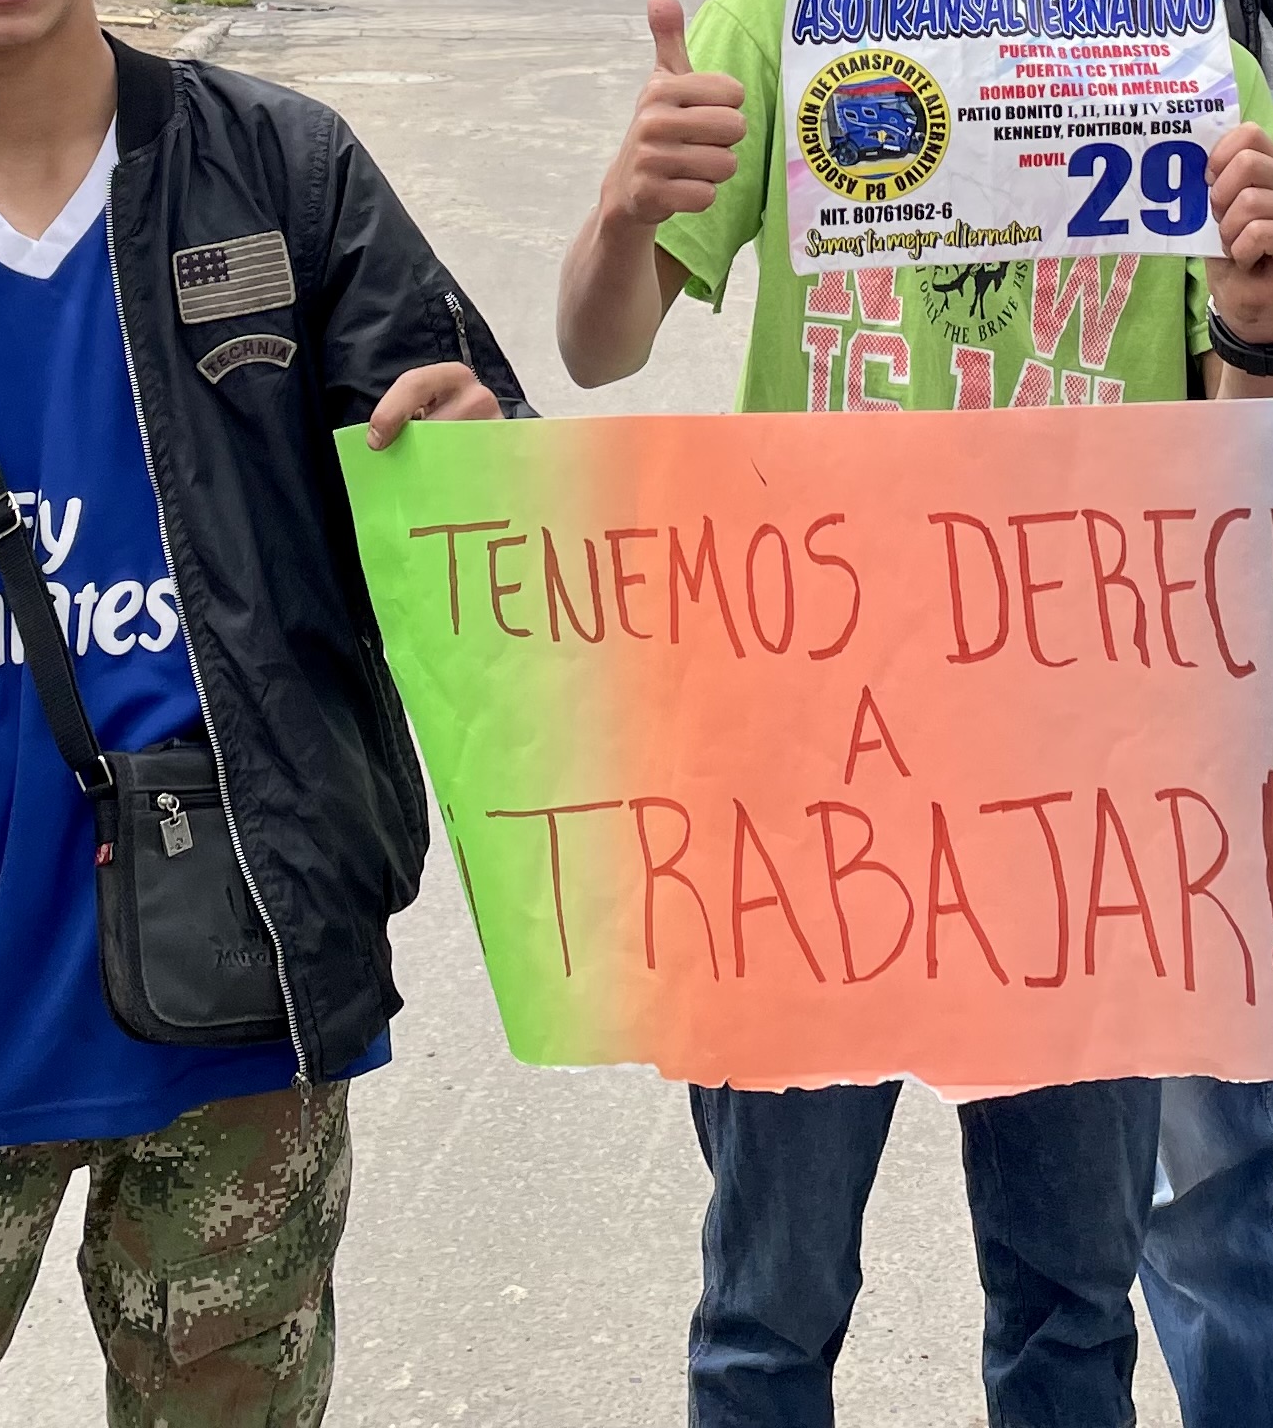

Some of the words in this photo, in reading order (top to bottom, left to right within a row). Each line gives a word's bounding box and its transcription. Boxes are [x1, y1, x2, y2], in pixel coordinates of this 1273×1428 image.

[999, 45, 1055, 59] PUERTA
[1058, 46, 1068, 59] 8
[1070, 44, 1171, 59] CORABASTOS
[826, 53, 933, 95] TRANSPORTE
[1015, 64, 1073, 78] PUERTA
[1074, 65, 1083, 77] 1
[1086, 64, 1107, 77] CC
[1109, 62, 1160, 77] TINTAL
[809, 77, 833, 102] DE
[980, 84, 1045, 101] ROMBOY
[1088, 82, 1118, 97] CON
[1121, 79, 1200, 96] AMÉRICAS
[957, 106, 1001, 122] PATIO
[1005, 104, 1063, 121] BONITO
[1104, 103, 1125, 117] III
[1130, 103, 1139, 118] y
[1142, 101, 1162, 115] IV
[1166, 98, 1225, 115] SECTOR
[893, 92, 947, 192] ALTERNATIVO
[993, 125, 1064, 142] KENNEDY,
[1067, 121, 1147, 138] FONTIBON,
[1150, 119, 1192, 135] BOSA
[798, 101, 859, 195] ASOCIACIÓN
[1019, 152, 1067, 168] MOVIL
[866, 183, 886, 201] P8
[1066, 140, 1210, 238] 29
[820, 208, 849, 226] NIT.
[854, 202, 953, 224] 80761962-6
[805, 228, 864, 257] Somos
[886, 229, 943, 260] mejor
[944, 219, 1043, 248] alternativa
[1013, 261, 1029, 290] SEL
[919, 280, 939, 325] ONLY
[943, 320, 970, 344] THE
[978, 295, 1019, 342] BRAVE
[843, 687, 911, 784] A
